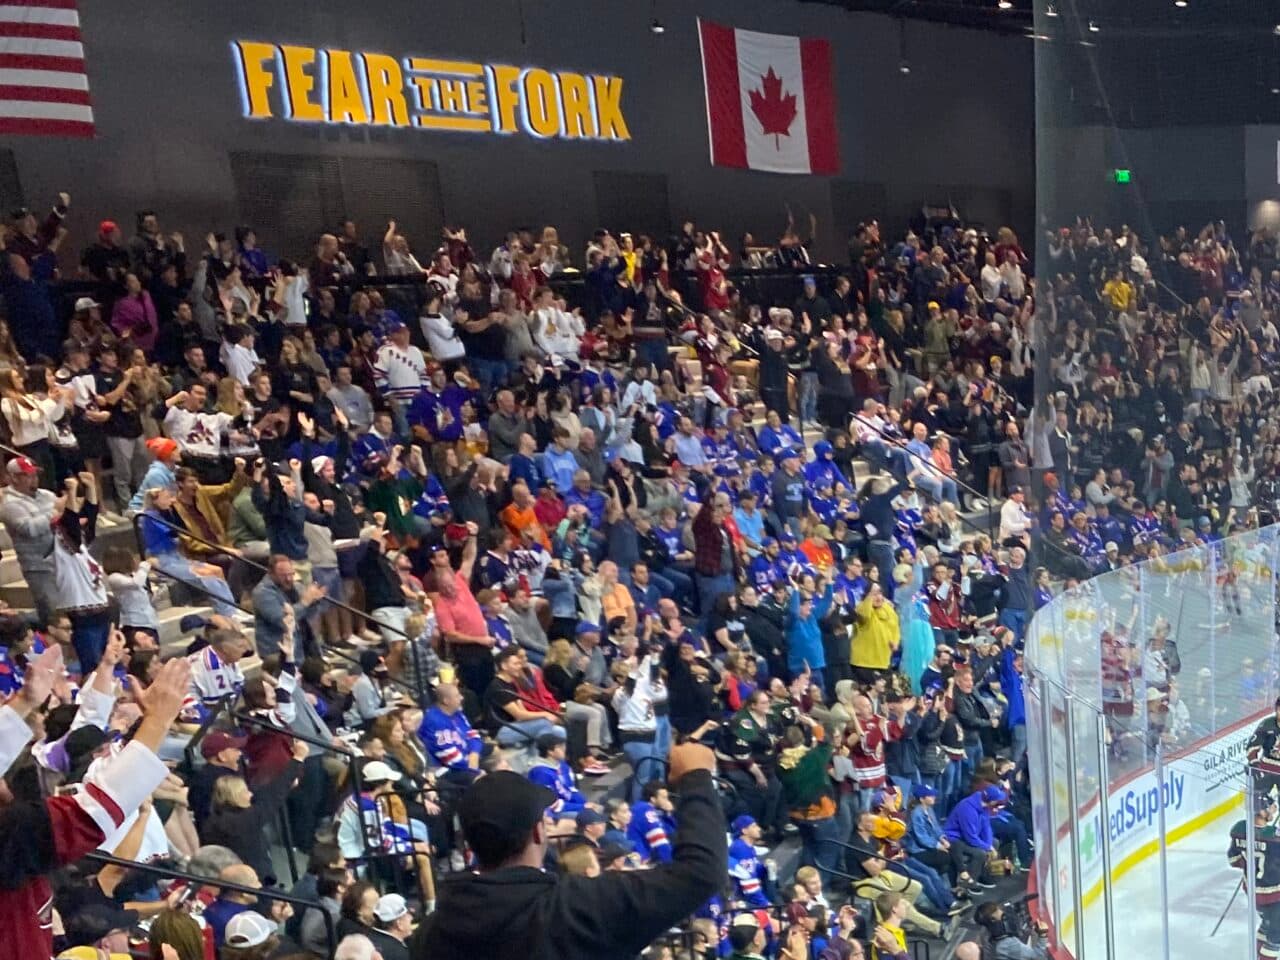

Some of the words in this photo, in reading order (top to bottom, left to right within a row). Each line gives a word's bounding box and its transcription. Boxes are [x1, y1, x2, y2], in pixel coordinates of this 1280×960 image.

[231, 40, 410, 128] FEAR
[410, 77, 488, 113] THE
[486, 64, 632, 141] FORK
[1203, 749, 1226, 771] GILA
